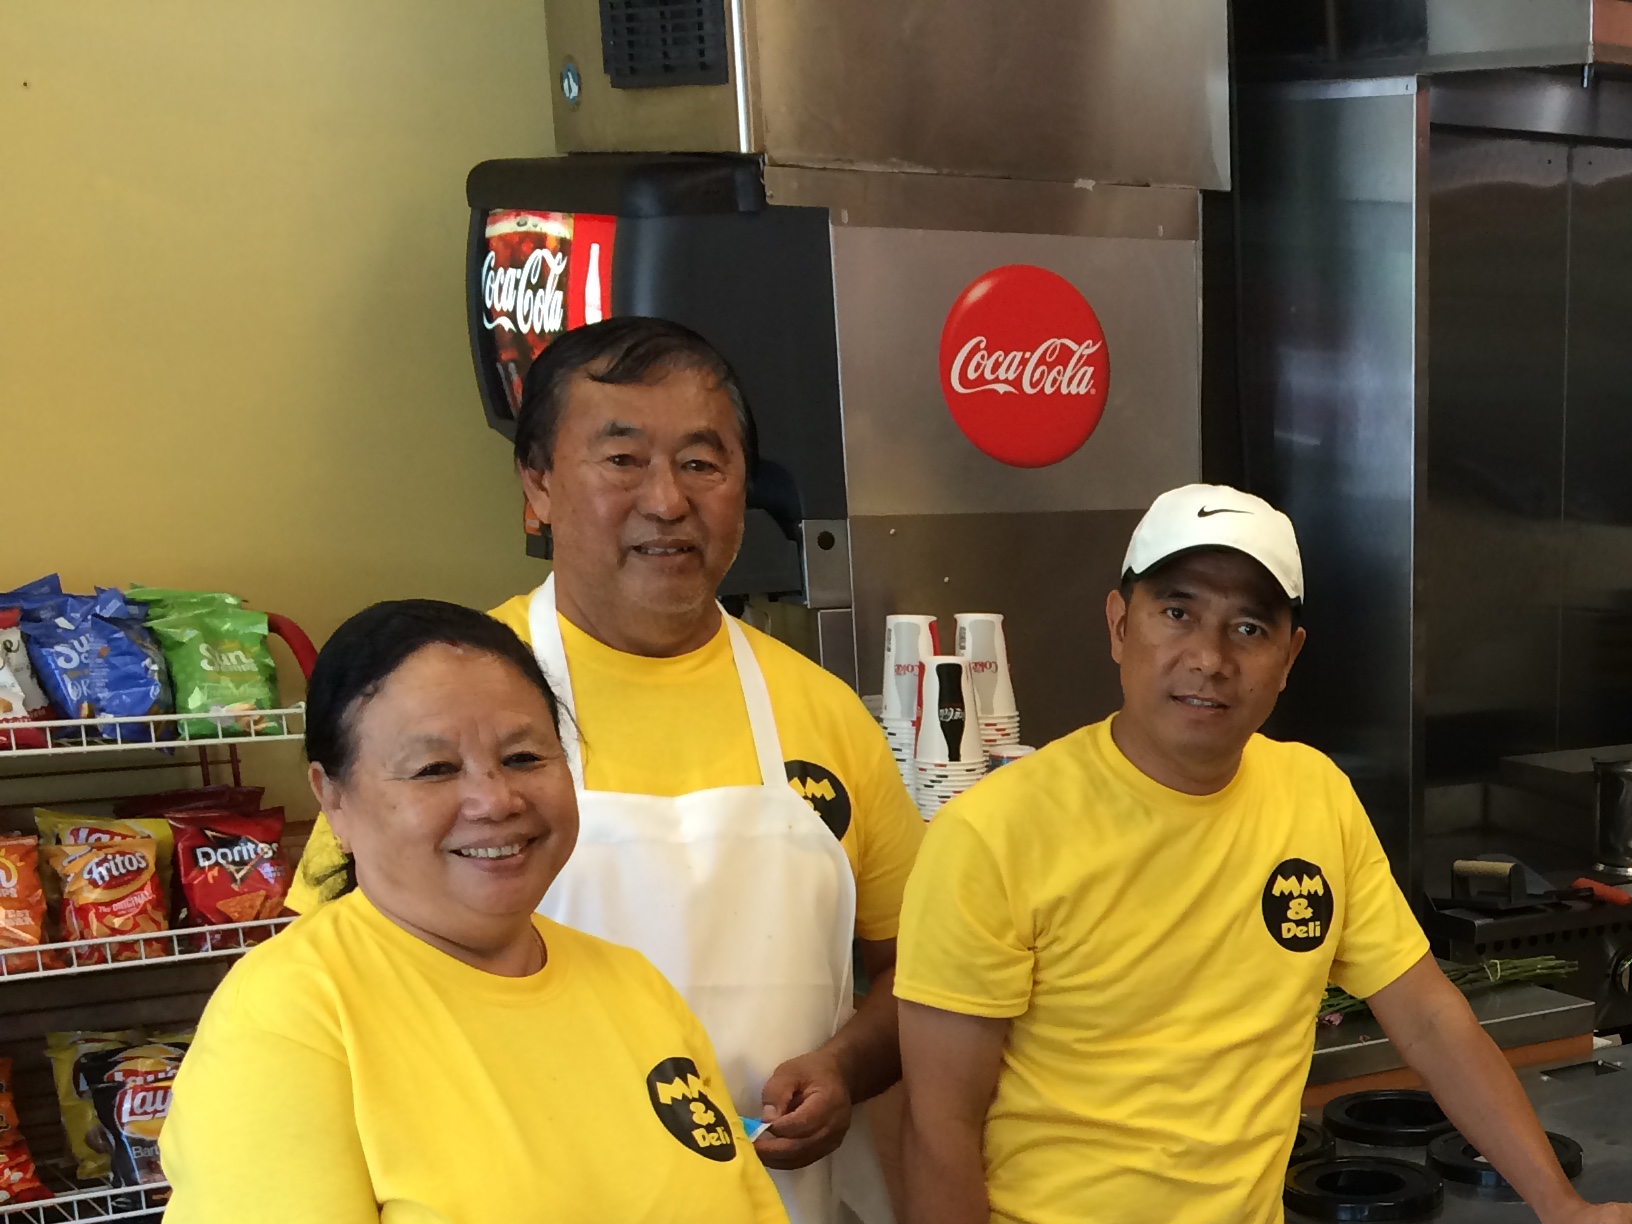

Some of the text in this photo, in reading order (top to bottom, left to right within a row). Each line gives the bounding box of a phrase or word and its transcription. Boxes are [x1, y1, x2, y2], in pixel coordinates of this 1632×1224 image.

[482, 248, 568, 335] Coca-Cola
[951, 335, 1102, 395] Coca-Cola
[199, 643, 255, 671] Sun
[83, 852, 148, 885] Fritos
[1271, 873, 1324, 897] MM
[1287, 898, 1313, 920] &
[1281, 920, 1321, 939] Deli
[689, 1101, 716, 1126] &
[691, 1126, 731, 1148] Deli
